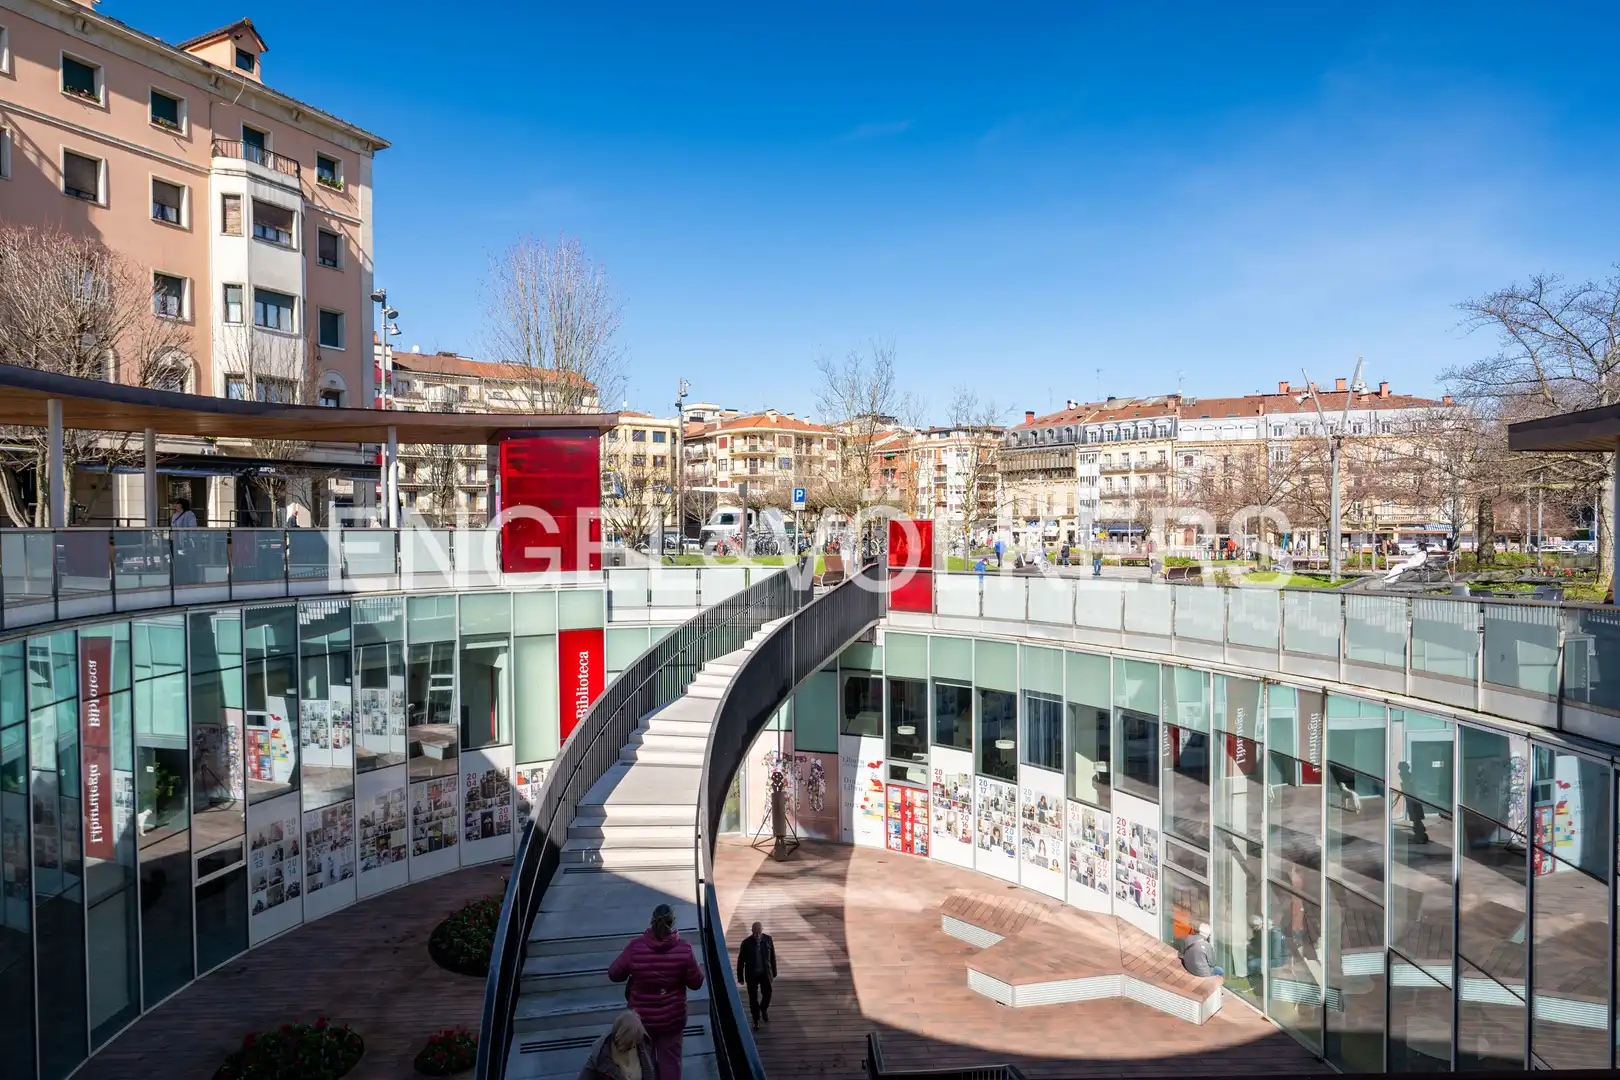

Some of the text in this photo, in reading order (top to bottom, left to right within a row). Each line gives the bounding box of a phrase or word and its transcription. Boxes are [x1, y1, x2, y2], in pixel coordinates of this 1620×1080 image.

[796, 489, 804, 501] P
[576, 650, 589, 719] Biblioteca
[979, 779, 988, 787] 20
[1024, 788, 1032, 796] 20
[286, 818, 296, 827] 20
[1117, 817, 1126, 826] 20
[1005, 827, 1014, 835] 20
[1117, 826, 1126, 836] 23
[253, 851, 264, 861] 20
[287, 858, 296, 867] 20
[1146, 877, 1156, 887] 20
[1146, 887, 1156, 897] 24
